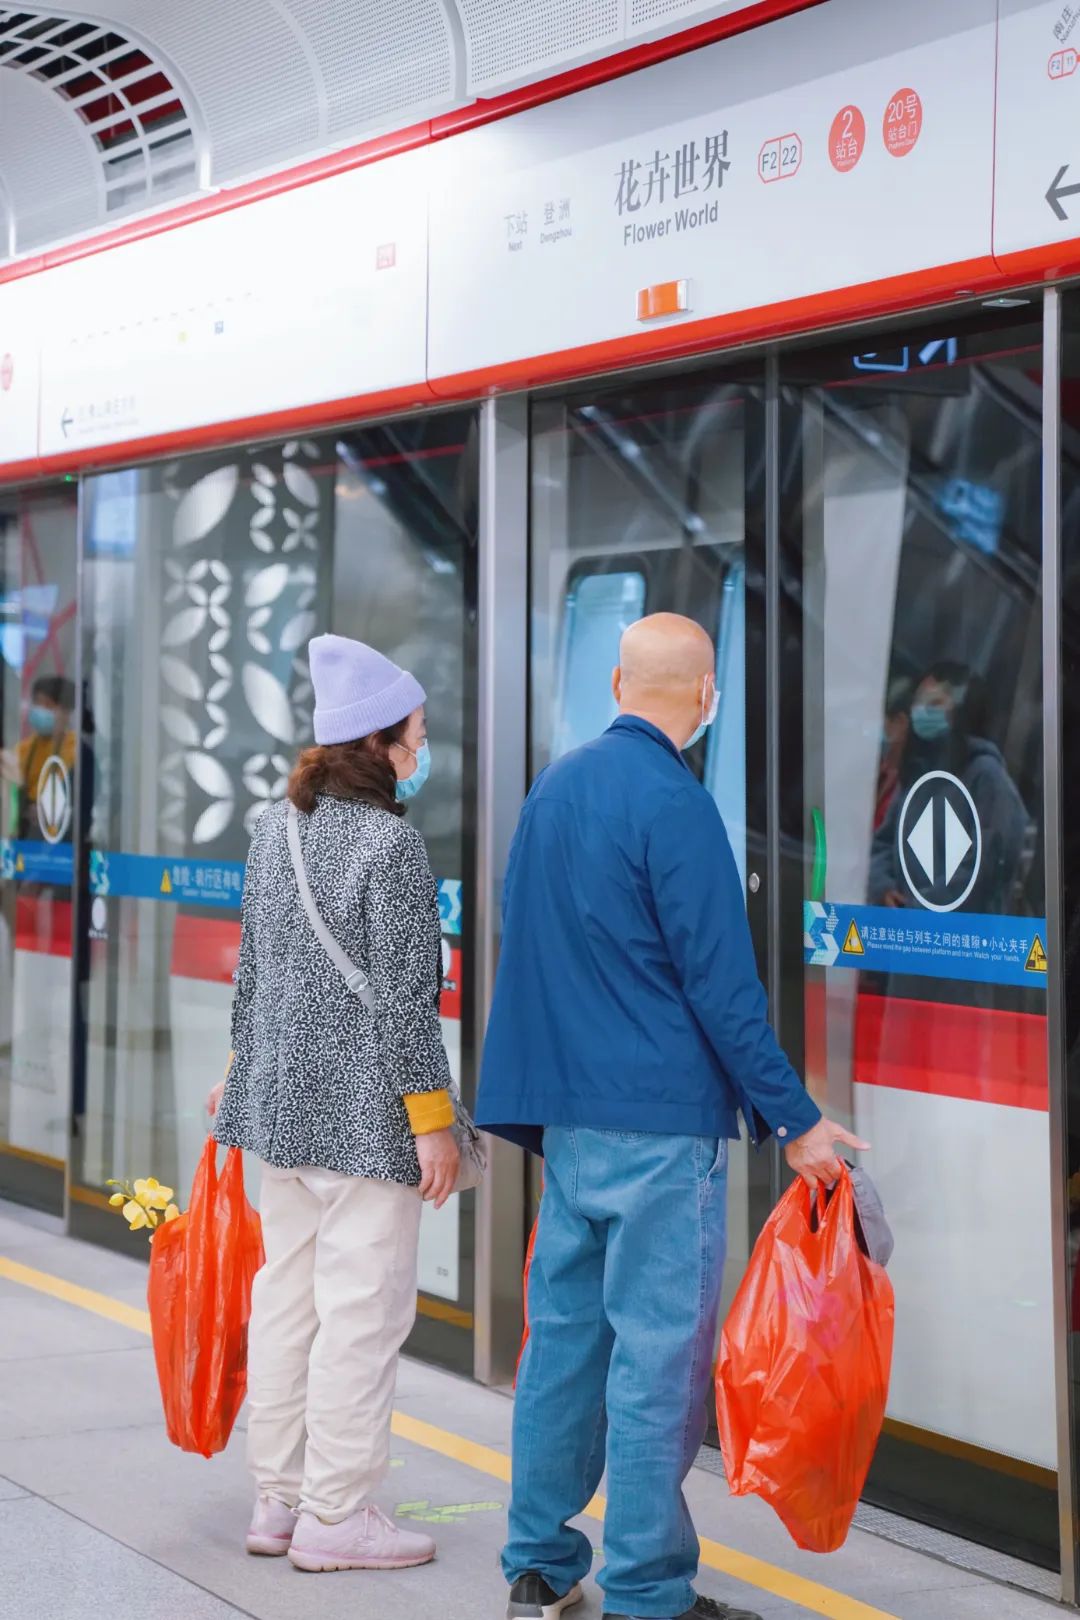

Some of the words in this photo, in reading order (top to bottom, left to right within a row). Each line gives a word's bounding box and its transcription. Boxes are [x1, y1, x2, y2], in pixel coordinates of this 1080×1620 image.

[841, 110, 853, 139] 2
[888, 120, 917, 141] 站台门
[761, 151, 777, 173] F2
[782, 144, 798, 167] 22
[835, 136, 858, 160] 站台
[614, 129, 732, 217] 花卉世界
[623, 218, 672, 246] Flower
[674, 200, 719, 233] World
